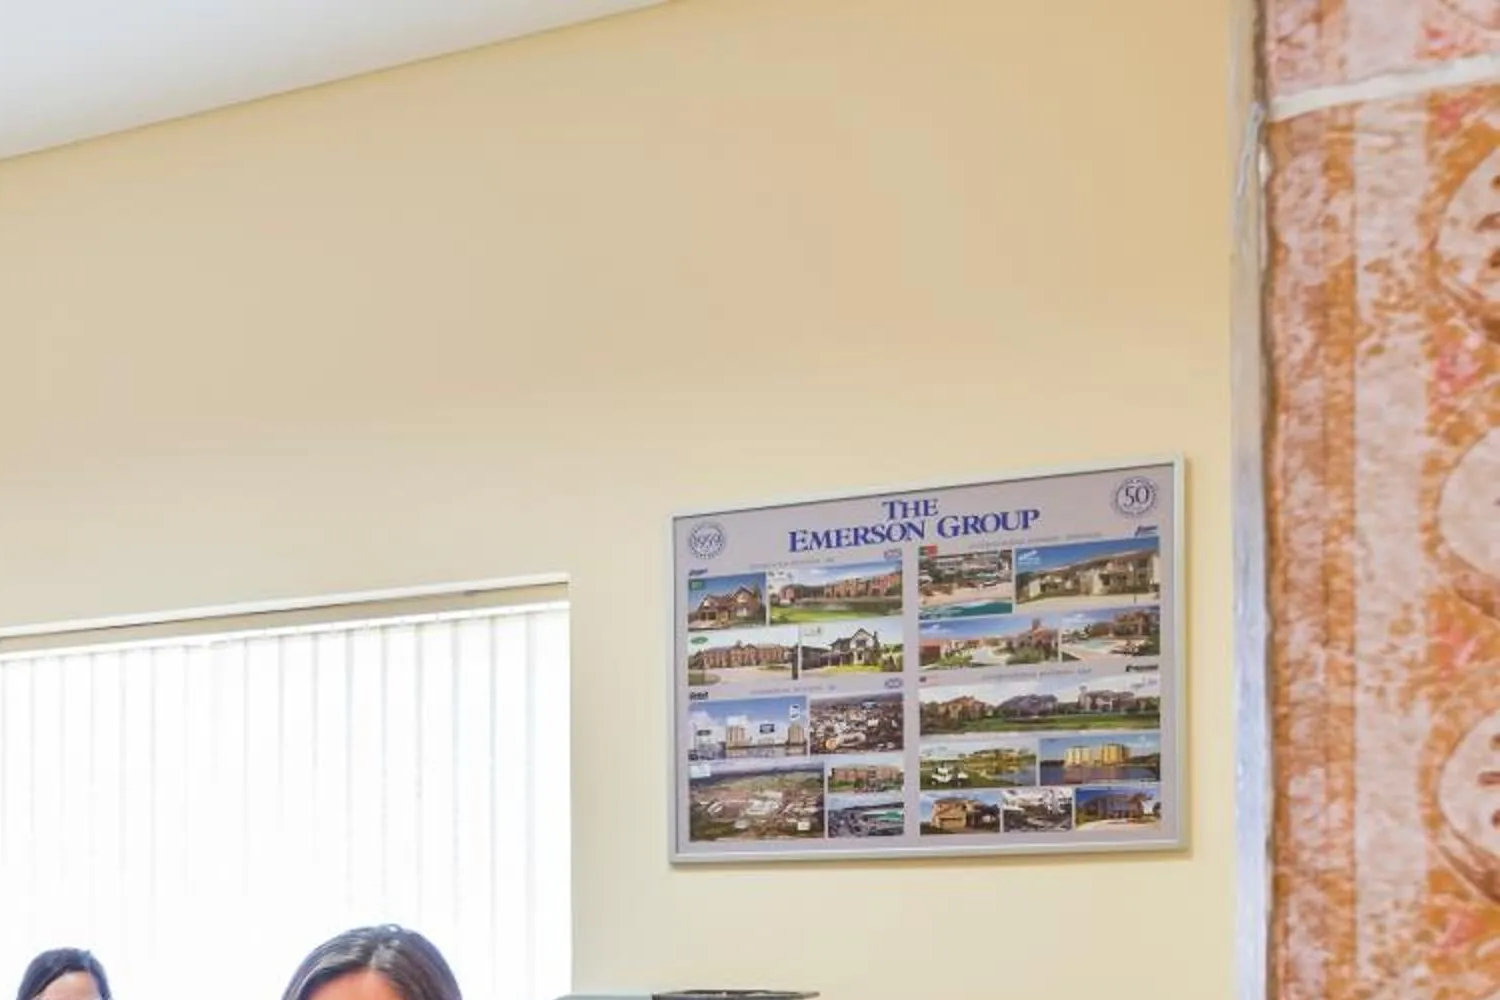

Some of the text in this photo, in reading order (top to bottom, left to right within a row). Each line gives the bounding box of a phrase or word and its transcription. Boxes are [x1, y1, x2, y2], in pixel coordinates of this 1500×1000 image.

[1123, 484, 1150, 508] 50
[882, 498, 939, 520] THE
[787, 508, 1041, 553] EMERSON GROUP
